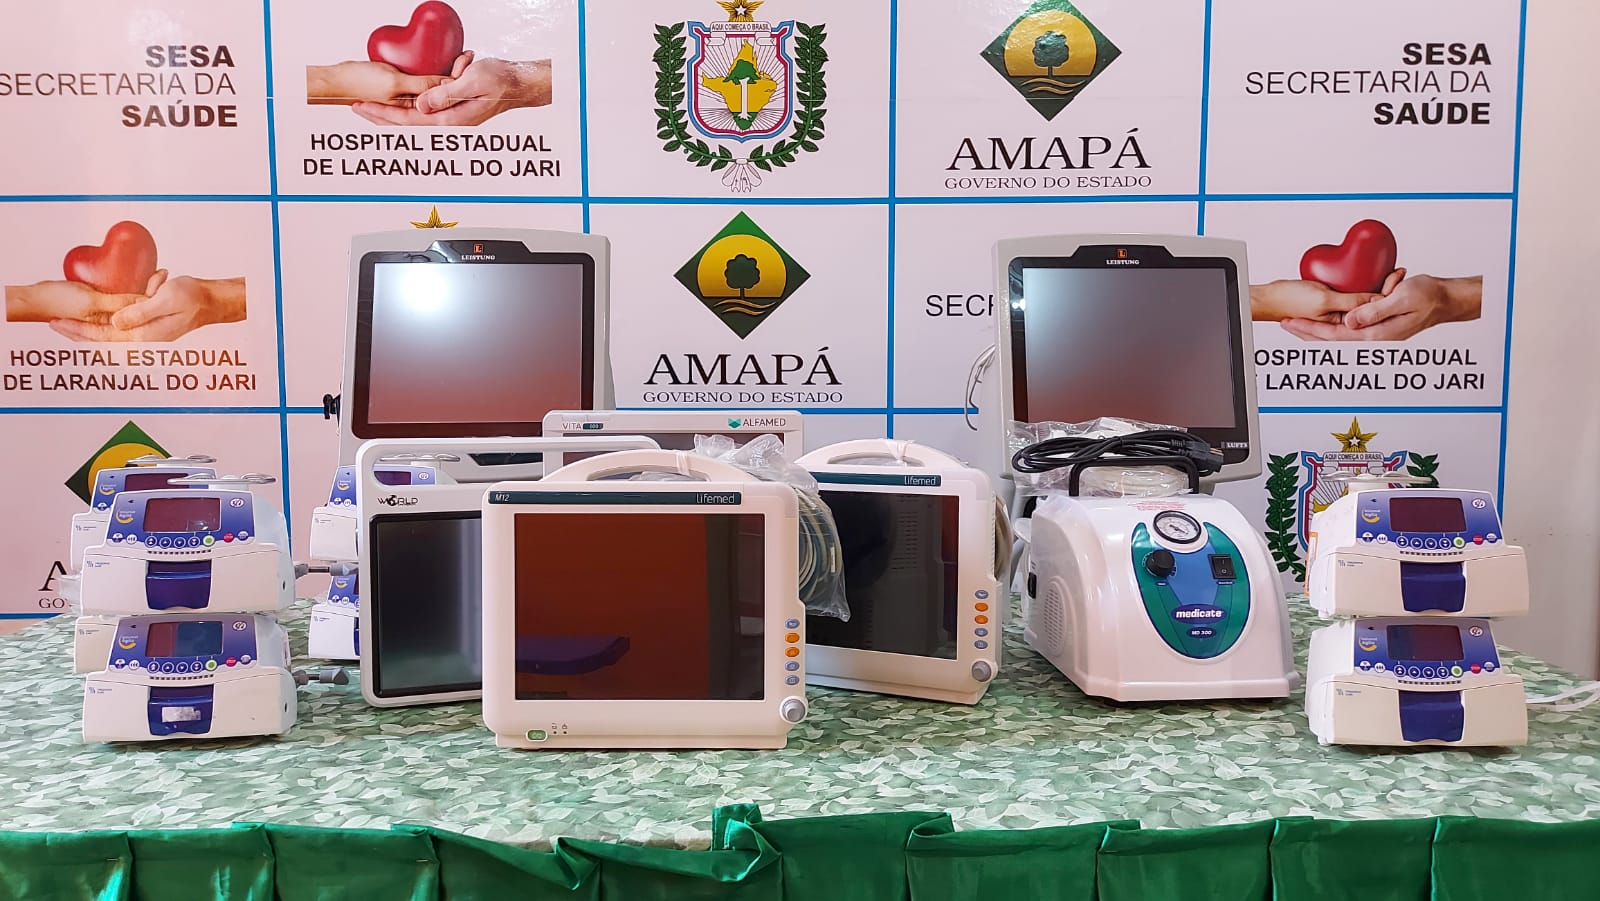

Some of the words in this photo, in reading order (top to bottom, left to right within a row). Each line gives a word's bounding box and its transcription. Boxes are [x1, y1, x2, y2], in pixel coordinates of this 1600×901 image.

[711, 23, 724, 31] AQUI
[751, 23, 769, 31] BRASIL
[146, 45, 236, 69] SESA
[1402, 43, 1493, 66] SESA
[0, 72, 184, 97] SECRETARIA
[194, 72, 237, 96] DA
[1244, 70, 1440, 95] SECRETARIA
[1449, 70, 1492, 94] DA
[121, 99, 239, 128] SAÚDE
[1373, 97, 1492, 126] SAÚDE
[311, 133, 423, 153] HOSPITAL
[430, 133, 553, 153] ESTADUAL
[944, 127, 1153, 171] AMAPÁ
[303, 158, 335, 177] DE
[341, 158, 463, 177] LARANJAL
[469, 159, 503, 178] DO
[509, 158, 562, 178] JARI
[944, 176, 1037, 190] GOVERNO
[1042, 176, 1071, 189] DO
[1075, 175, 1152, 189] ESTADO
[9, 349, 120, 368] HOSPITAL
[126, 349, 248, 368] ESTADUAL
[642, 346, 843, 386] AMAPÁ
[1254, 348, 1349, 367] OSPITAL
[1355, 348, 1478, 367] ESTADUAL
[2, 373, 34, 392] DE
[39, 373, 160, 392] LARANJAL
[165, 373, 200, 391] DO
[205, 373, 257, 392] JARI
[1265, 372, 1387, 391] LARANJAL
[1393, 372, 1428, 391] DO
[1432, 372, 1486, 391] JARI
[642, 391, 733, 404] GOVERNO
[738, 391, 766, 404] DO
[770, 391, 843, 404] ESTADO
[562, 422, 582, 430] VITA
[742, 417, 787, 428] ALFAMED
[904, 475, 937, 486] lifemed
[495, 493, 510, 502] M12
[696, 492, 735, 504] lifemed
[1175, 608, 1222, 619] medicate
